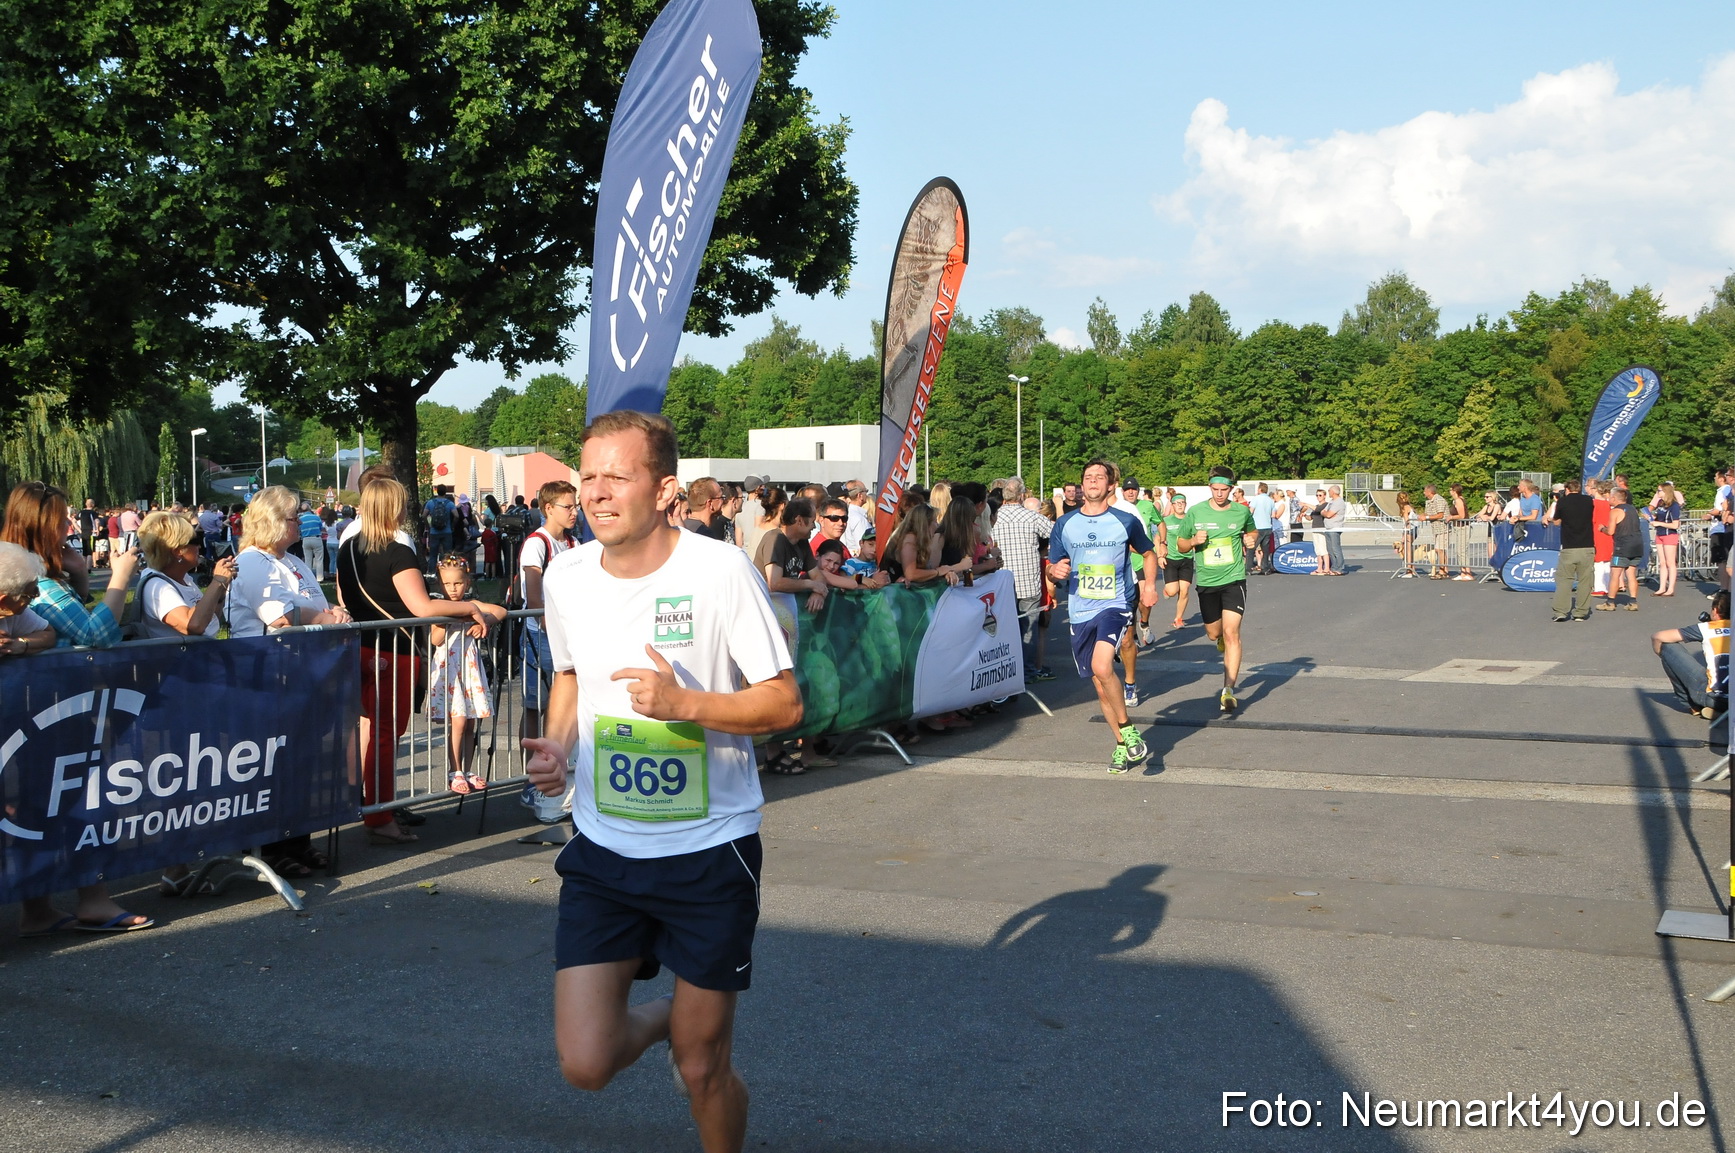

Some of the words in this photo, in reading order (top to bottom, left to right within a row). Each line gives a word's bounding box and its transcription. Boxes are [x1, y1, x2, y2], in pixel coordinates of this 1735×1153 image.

[628, 33, 718, 324] Fischer
[656, 76, 730, 315] AUTOMOBILE
[1588, 398, 1639, 462] Frischmann
[1213, 547, 1222, 559] 4
[1080, 575, 1114, 591] 1242
[1522, 567, 1557, 578] Fisch
[654, 612, 693, 624] MICKAN
[654, 640, 694, 650] meisterhaft
[978, 642, 1011, 666] Neumarkter
[970, 658, 1017, 692] Lammsbräu
[47, 732, 287, 818] Fischer
[609, 753, 687, 796] 869
[624, 795, 646, 805] Markus
[646, 798, 674, 806] Schmidt
[75, 788, 271, 851] AUTOMOBILE
